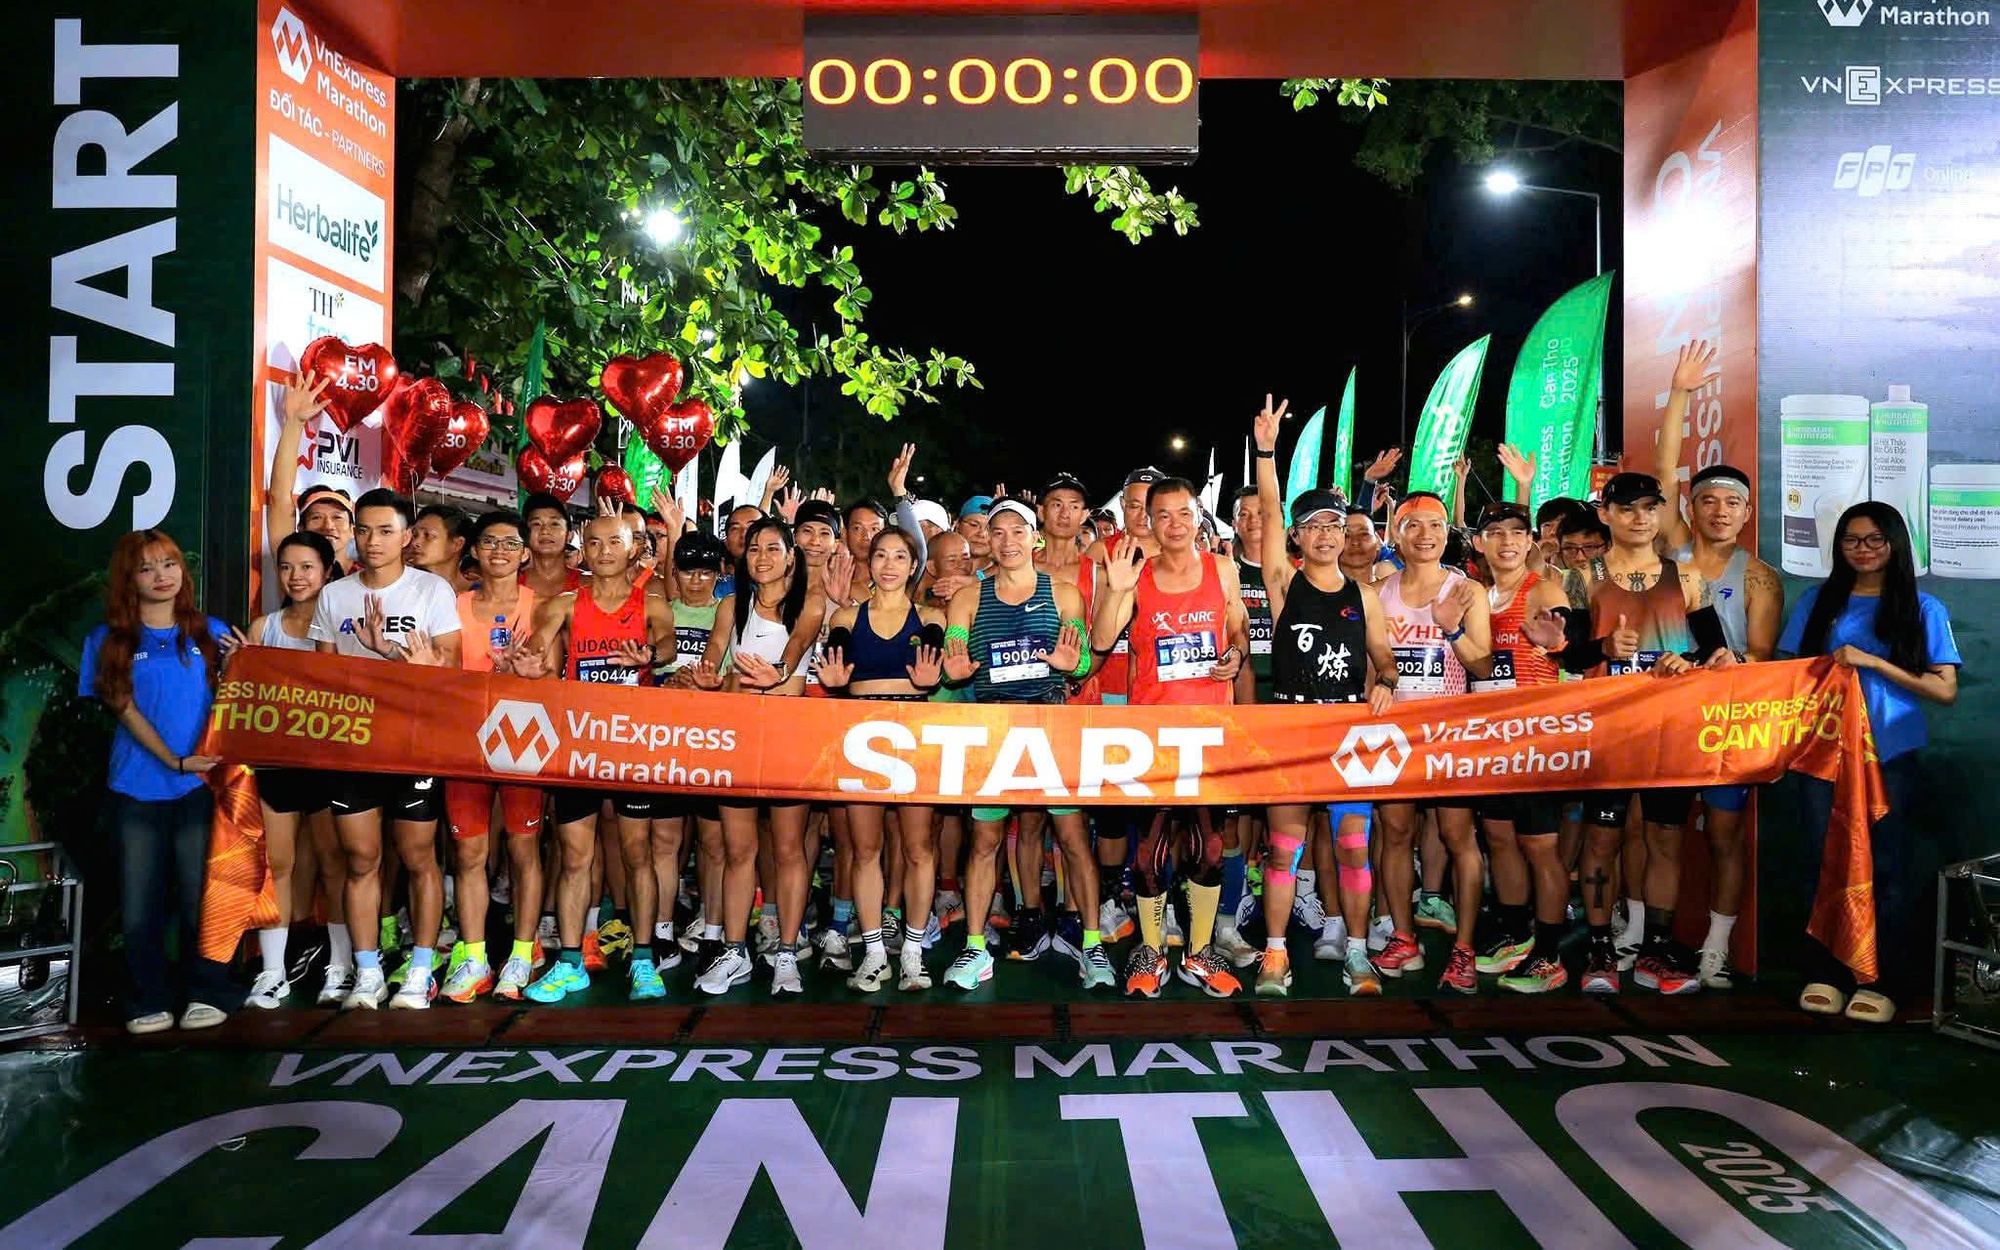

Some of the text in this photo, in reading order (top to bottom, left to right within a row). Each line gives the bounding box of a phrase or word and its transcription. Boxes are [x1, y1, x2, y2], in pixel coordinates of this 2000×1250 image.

[1880, 6, 1990, 26] Marathon
[314, 35, 386, 108] VnExpress
[808, 57, 1194, 105] 00:00:00
[1801, 66, 2000, 105] VNEXPRESS
[317, 71, 386, 138] Marathon
[270, 89, 295, 121] ĐỐI
[298, 106, 323, 137] TÁC
[331, 130, 386, 178] PARTNERS
[1834, 145, 1916, 197] FPT
[277, 183, 371, 263] Herbalife
[44, 18, 179, 531] START
[309, 287, 335, 319] TH
[1562, 356, 1579, 403] 2025
[317, 430, 360, 465] PVI
[659, 434, 696, 449] 3.30
[316, 459, 364, 480] INSURANCE
[1535, 425, 1555, 507] nExpress
[1178, 611, 1217, 625] CNRC
[1250, 627, 1273, 639] 901
[1491, 664, 1512, 678] 63
[258, 683, 375, 714] MARATHON
[1701, 691, 1844, 722] VNEXPRESS M
[212, 702, 372, 746] THO 2025
[566, 710, 737, 751] VnExpress
[1421, 711, 1595, 745] VnExpress
[1698, 721, 1772, 753] CAN
[1779, 712, 1843, 747] THO
[568, 749, 733, 788] Marathon
[838, 720, 1224, 798] START
[1425, 747, 1592, 782] Marathon
[267, 1033, 1734, 1087] VNEXPRESS MARATHON
[0, 1082, 1999, 1250] CAN THO
[1678, 1140, 1842, 1216] 2025
